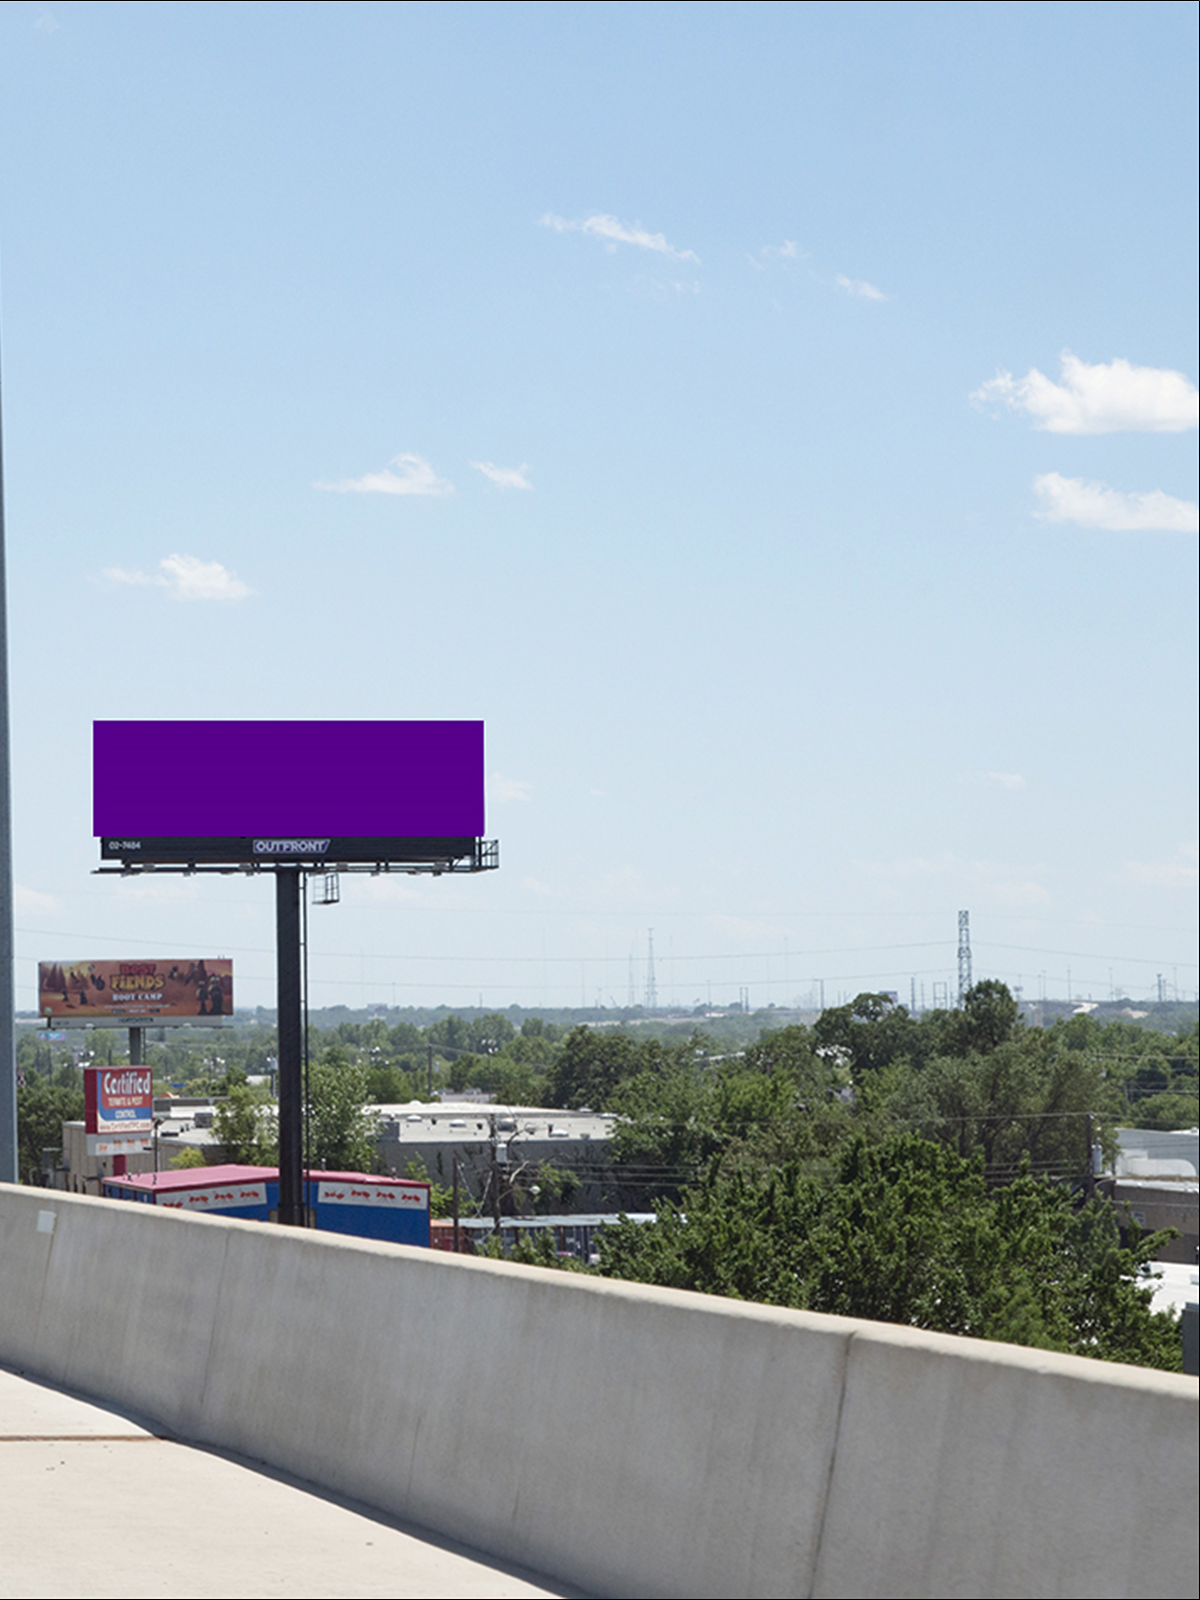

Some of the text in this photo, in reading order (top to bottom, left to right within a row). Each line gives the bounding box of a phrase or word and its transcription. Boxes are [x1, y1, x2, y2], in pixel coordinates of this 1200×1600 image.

[256, 841, 326, 853] OUTFRONT
[138, 992, 163, 1001] CAMP
[104, 1070, 151, 1095] Certified
